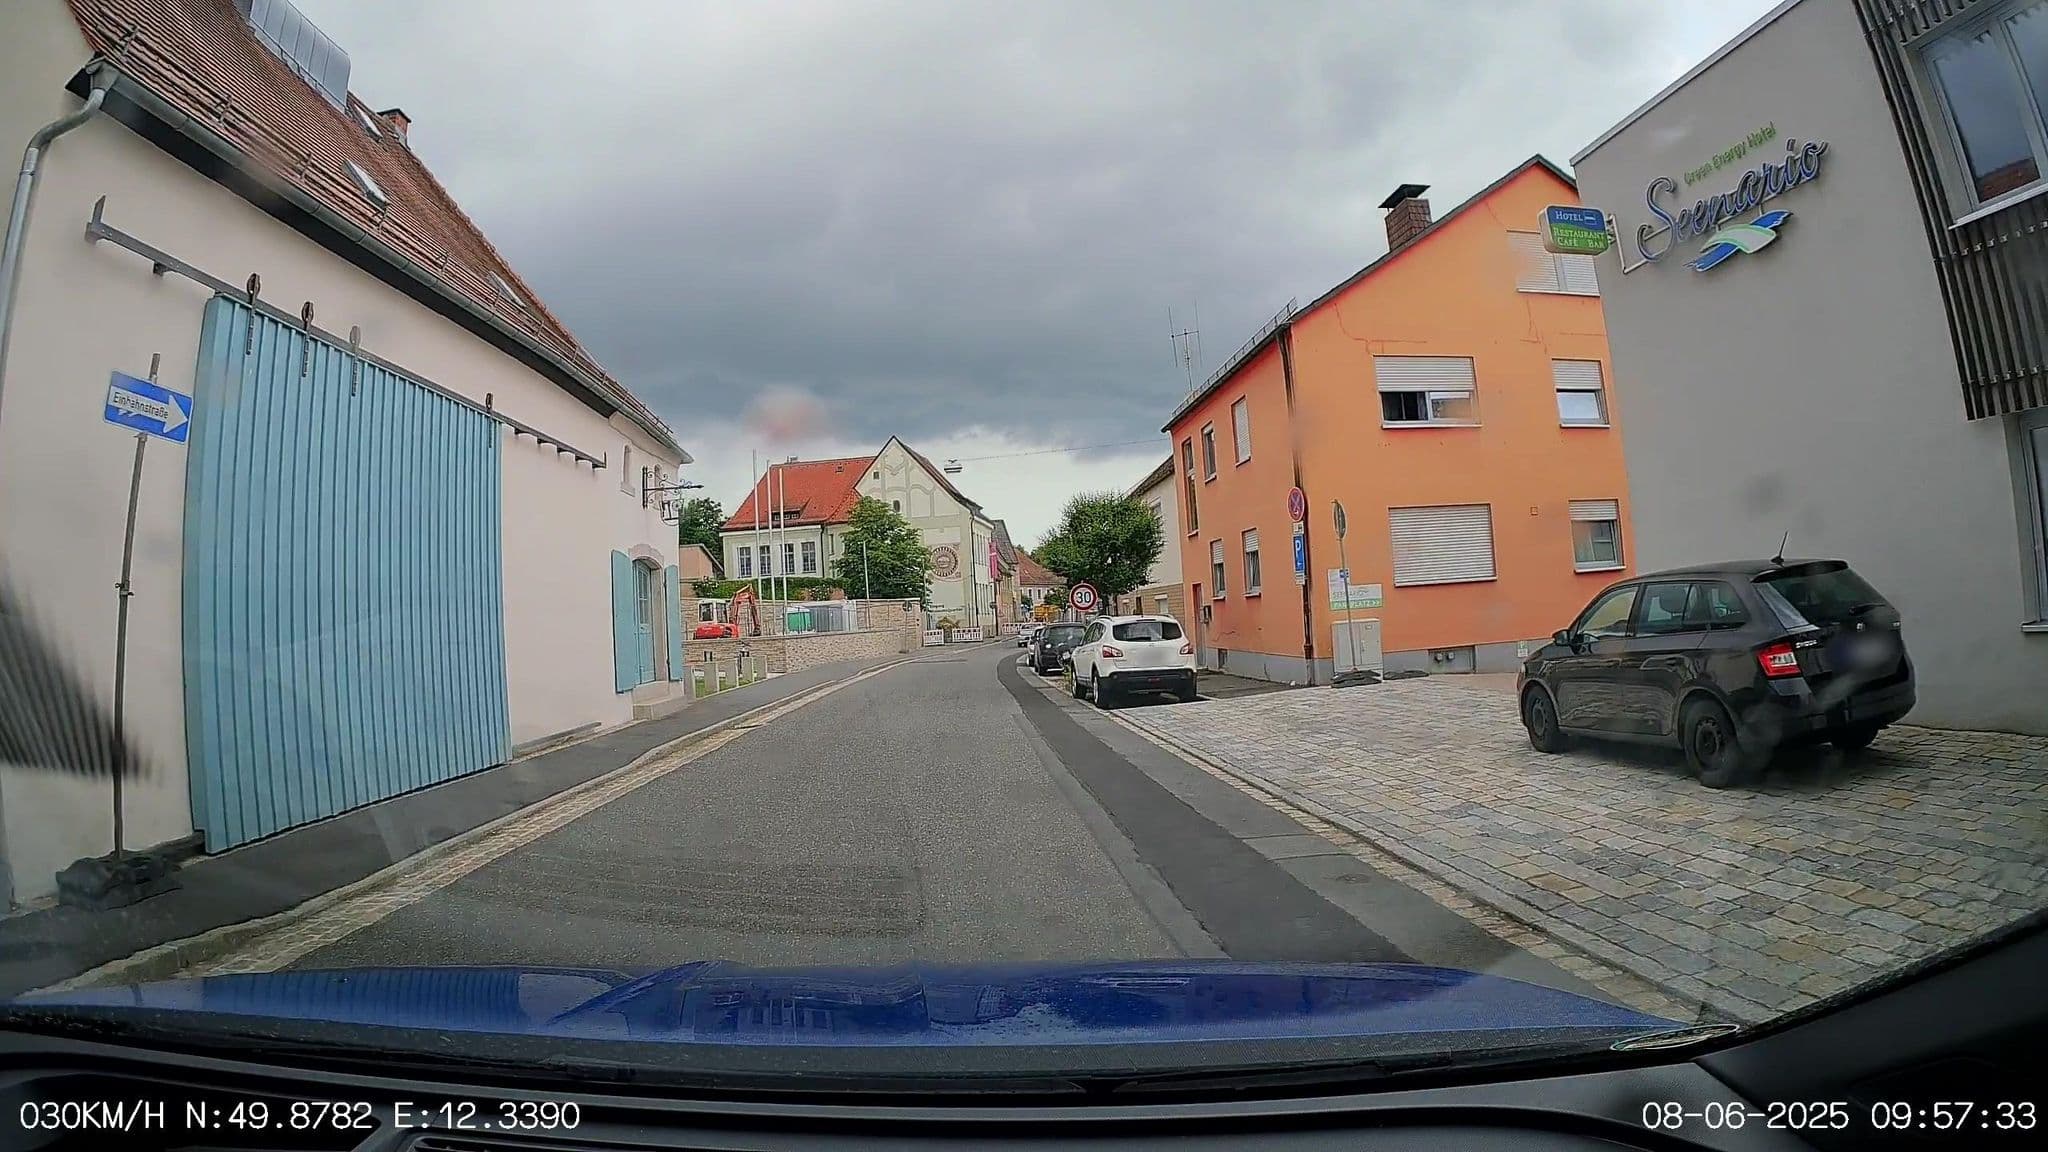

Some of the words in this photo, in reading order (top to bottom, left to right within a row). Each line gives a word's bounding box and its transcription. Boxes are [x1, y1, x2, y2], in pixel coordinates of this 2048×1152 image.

[1684, 163, 1713, 187] Green
[1712, 142, 1747, 171] Energy
[1747, 120, 1777, 149] Hotel
[1636, 137, 1829, 261] Seenario
[112, 391, 169, 420] Einbahnstraße
[1076, 591, 1092, 604] 30
